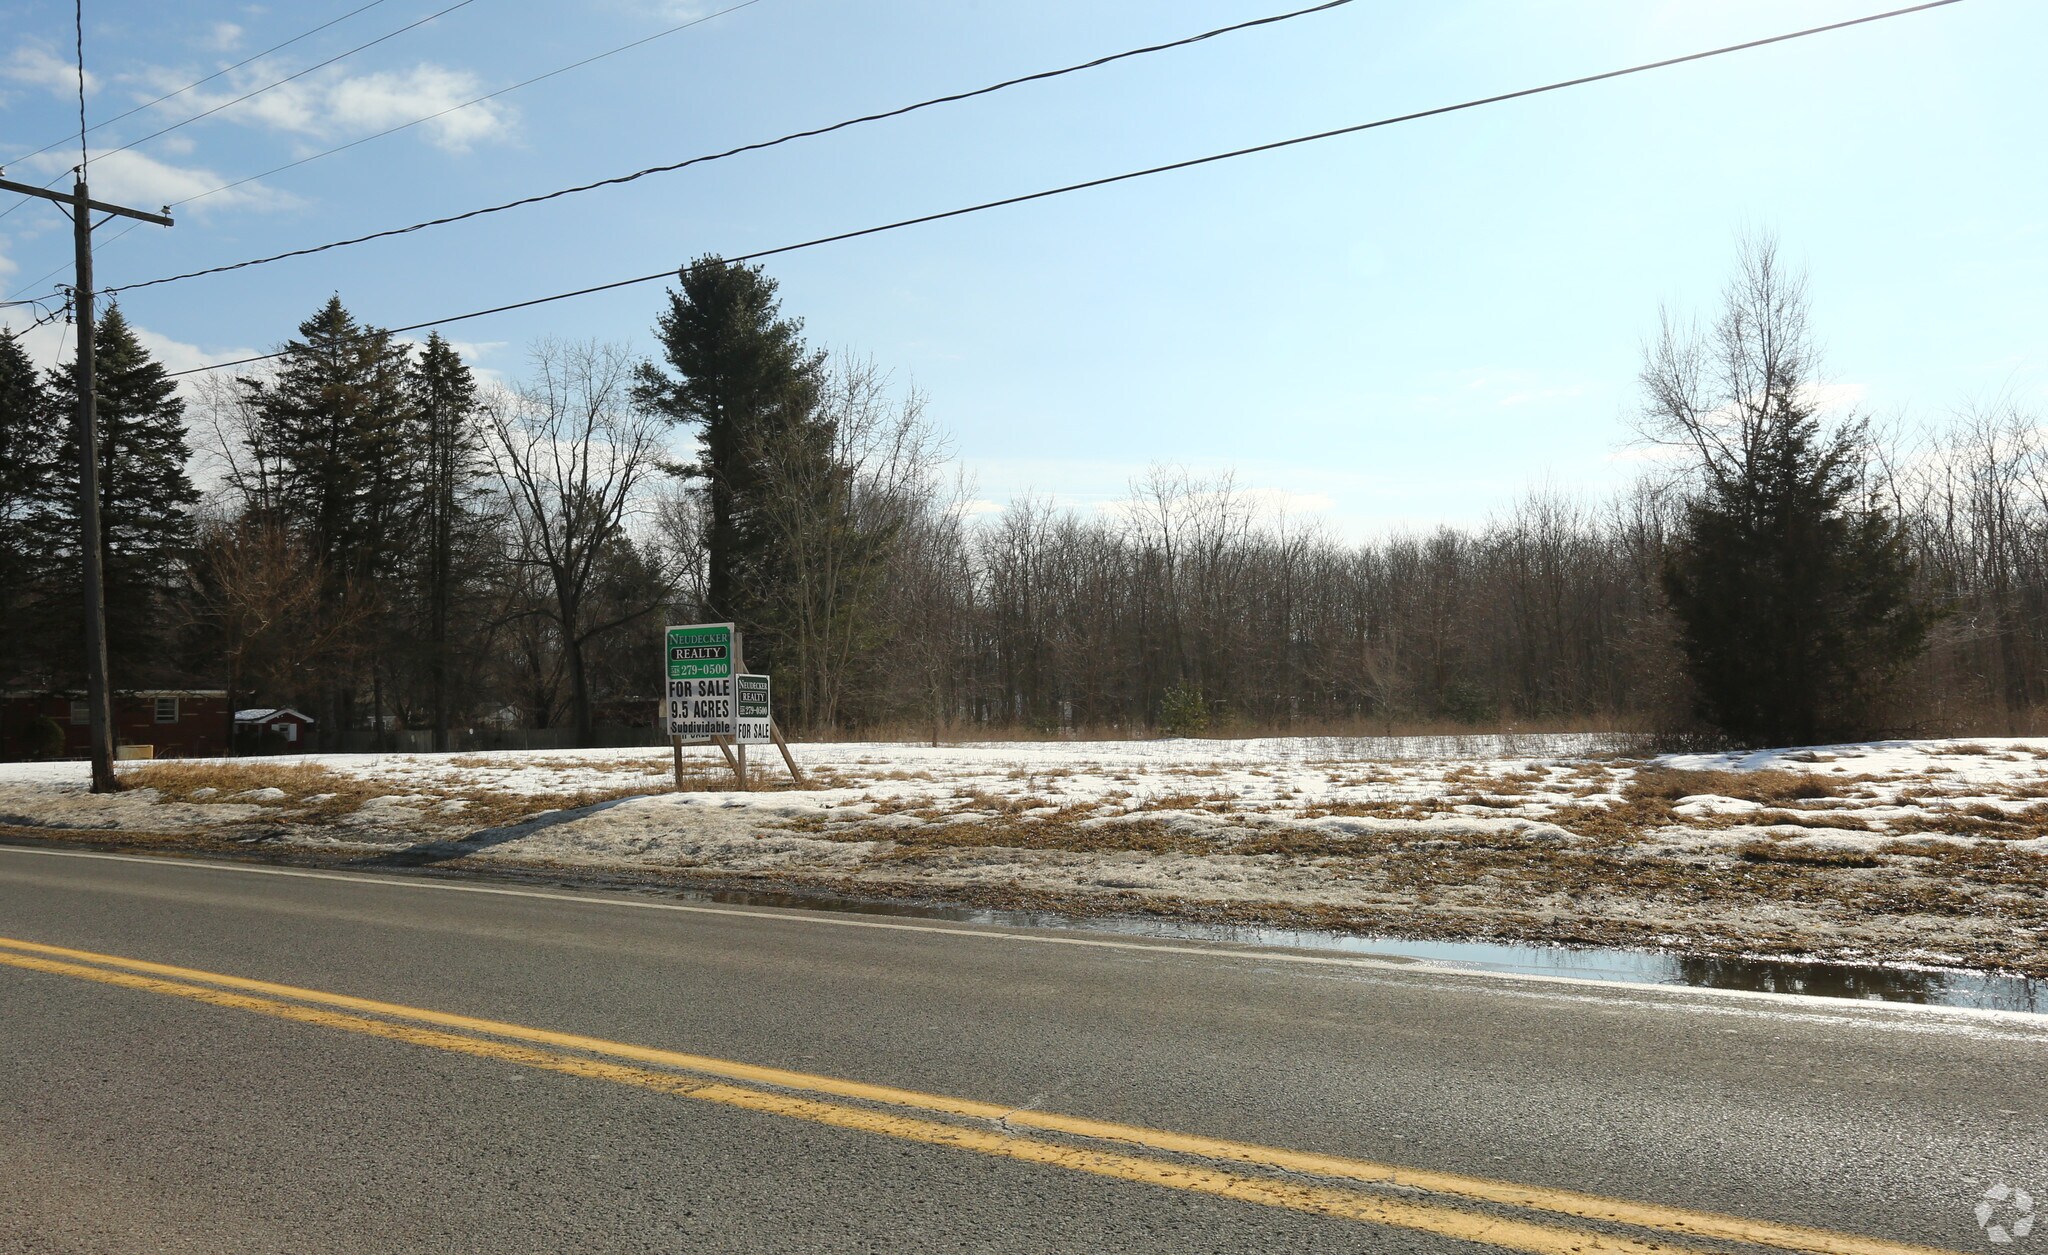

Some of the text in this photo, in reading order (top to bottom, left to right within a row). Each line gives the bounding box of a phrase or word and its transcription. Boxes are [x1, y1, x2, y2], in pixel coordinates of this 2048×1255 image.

[670, 634, 728, 645] NEUDECKER
[676, 647, 721, 659] REALTY
[681, 664, 727, 676] 279-0500
[669, 680, 730, 697] FOR SALE
[739, 680, 767, 690] NEUDECKER
[742, 693, 764, 701] REALTY
[671, 701, 688, 718] 9.5
[694, 700, 729, 718] ACRES
[671, 721, 730, 733] Subdividable
[738, 723, 769, 738] FOR SALE
